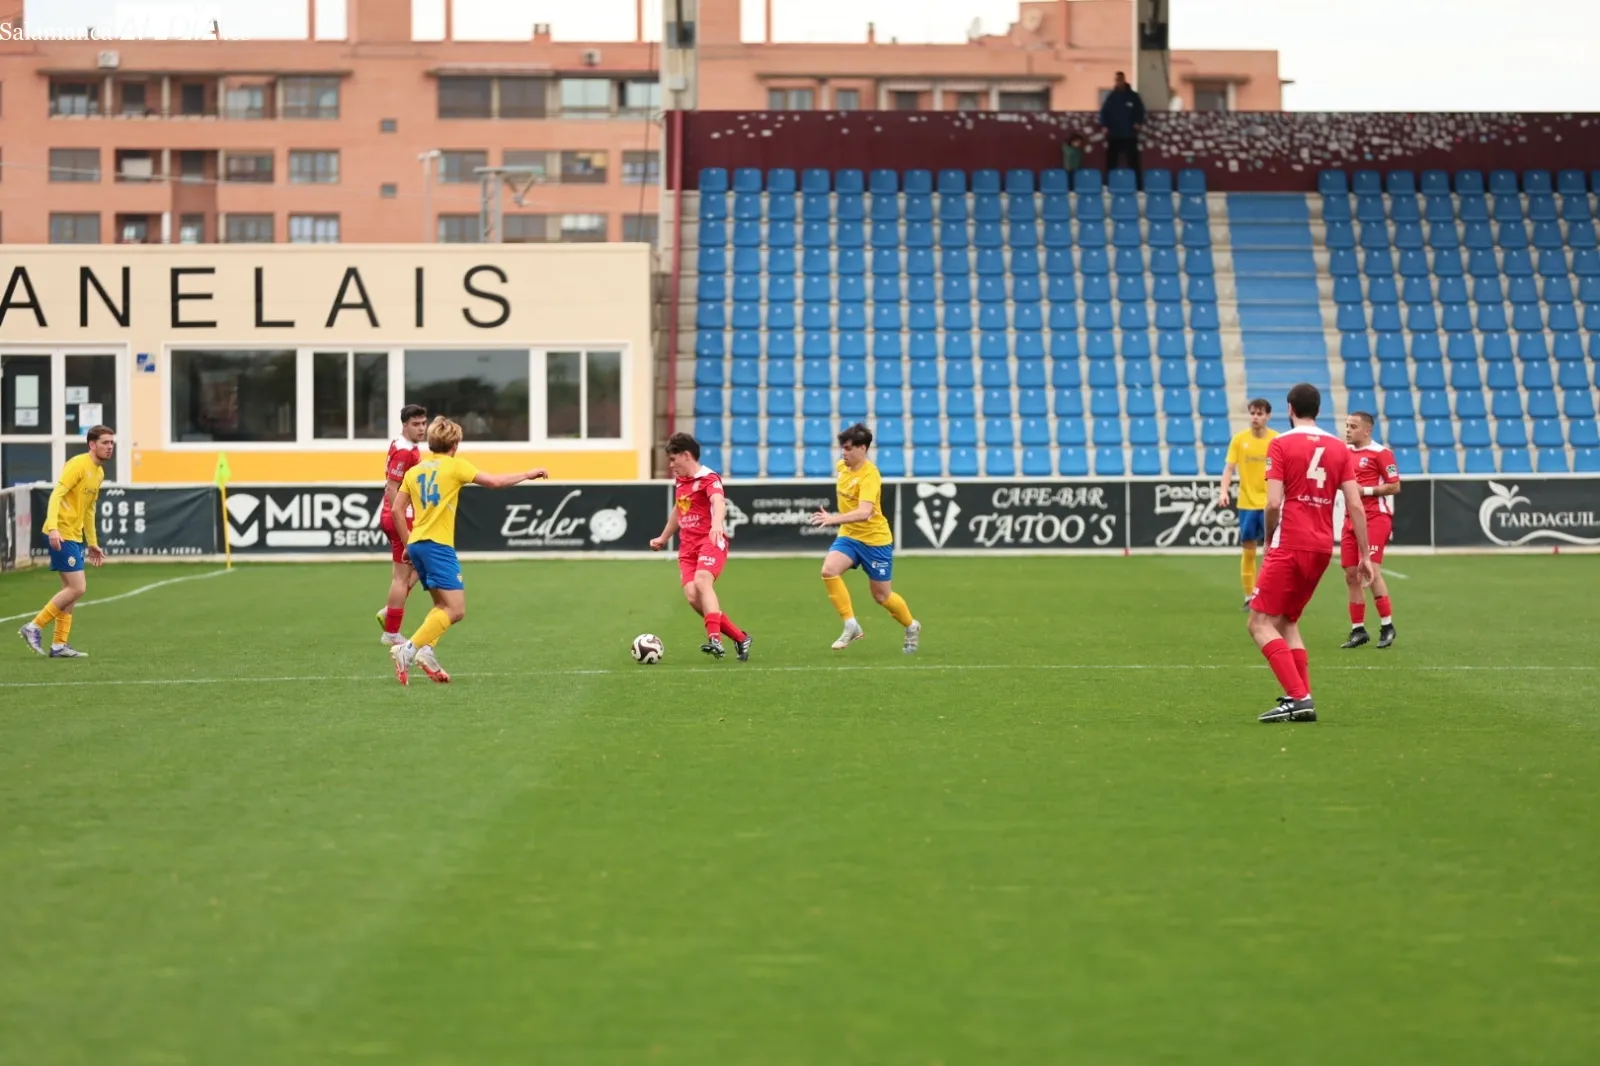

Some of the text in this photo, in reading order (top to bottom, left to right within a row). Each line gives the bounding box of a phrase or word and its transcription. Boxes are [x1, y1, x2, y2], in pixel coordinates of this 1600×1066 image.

[1306, 447, 1327, 489] 4
[416, 470, 440, 509] 14
[991, 486, 1108, 509] CAFE-BAR
[101, 501, 146, 516] OSE
[500, 488, 586, 538] Eider
[101, 518, 146, 534] UIS
[1496, 511, 1600, 528] TARDAGUIL
[333, 529, 389, 546] SERVI
